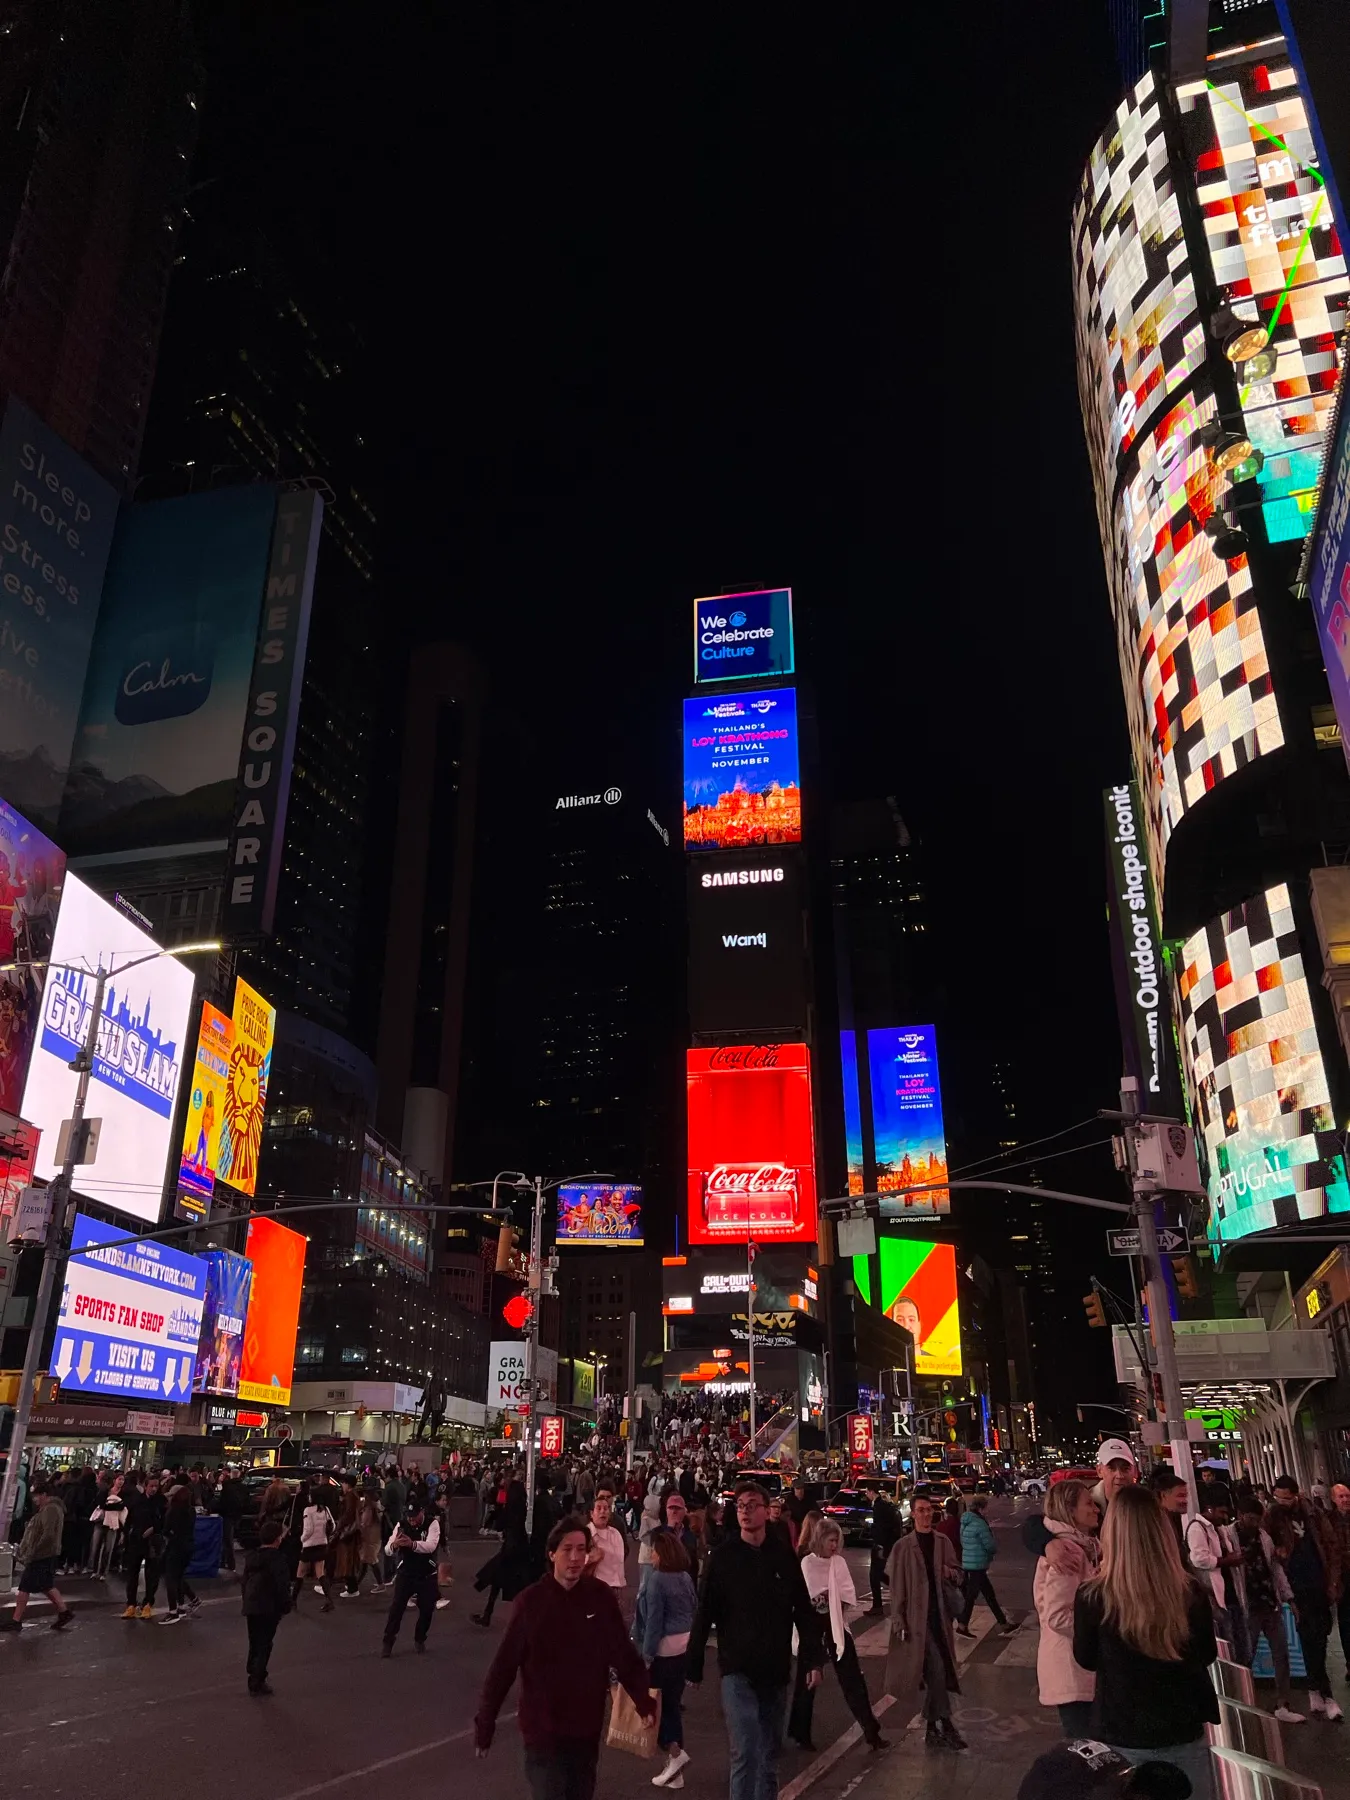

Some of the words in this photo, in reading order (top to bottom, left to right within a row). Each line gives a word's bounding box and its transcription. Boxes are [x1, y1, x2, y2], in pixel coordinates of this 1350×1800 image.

[20, 443, 91, 522] Sleep
[12, 480, 86, 557] more.
[2, 523, 79, 605] Stress
[0, 555, 51, 623] ess.
[701, 615, 727, 629] We
[0, 618, 40, 668] ive
[701, 627, 774, 644] Celebrate
[701, 646, 755, 660] Culture
[124, 659, 205, 697] Calm
[692, 736, 716, 747] LOY
[719, 729, 788, 744] KRATHONG
[713, 723, 765, 733] THAILAND'S
[714, 743, 765, 754] FESTIVAL
[712, 756, 770, 769] NOVEMBER
[231, 690, 278, 904] SQUARE
[555, 794, 601, 810] Allianz
[1109, 785, 1136, 843] iconic
[701, 868, 784, 888] SAMSUNG
[1121, 844, 1147, 910] shape
[1130, 914, 1159, 1009] Outdoor
[243, 1015, 267, 1049] CALLING
[111, 1072, 126, 1086] YORK
[905, 1079, 925, 1088] LOY
[715, 1213, 739, 1221] ICE
[750, 1212, 787, 1220] COLD
[703, 1275, 724, 1287] CALL
[74, 1294, 117, 1323] SPORTS
[117, 1305, 137, 1328] FAN
[139, 1311, 164, 1333] SHOP
[108, 1342, 139, 1371] VISIT
[140, 1349, 156, 1372] US
[94, 1372, 100, 1383] 3
[100, 1371, 123, 1387] FLOORS
[123, 1373, 132, 1388] OF
[132, 1375, 160, 1391] SHOPPING
[44, 1416, 59, 1424] EAGLE
[211, 1406, 225, 1418] BLUE
[79, 1419, 101, 1427] AMERICAN
[101, 1420, 114, 1428] EAGLE
[545, 1418, 561, 1450] tkts
[853, 1417, 869, 1451] tkts
